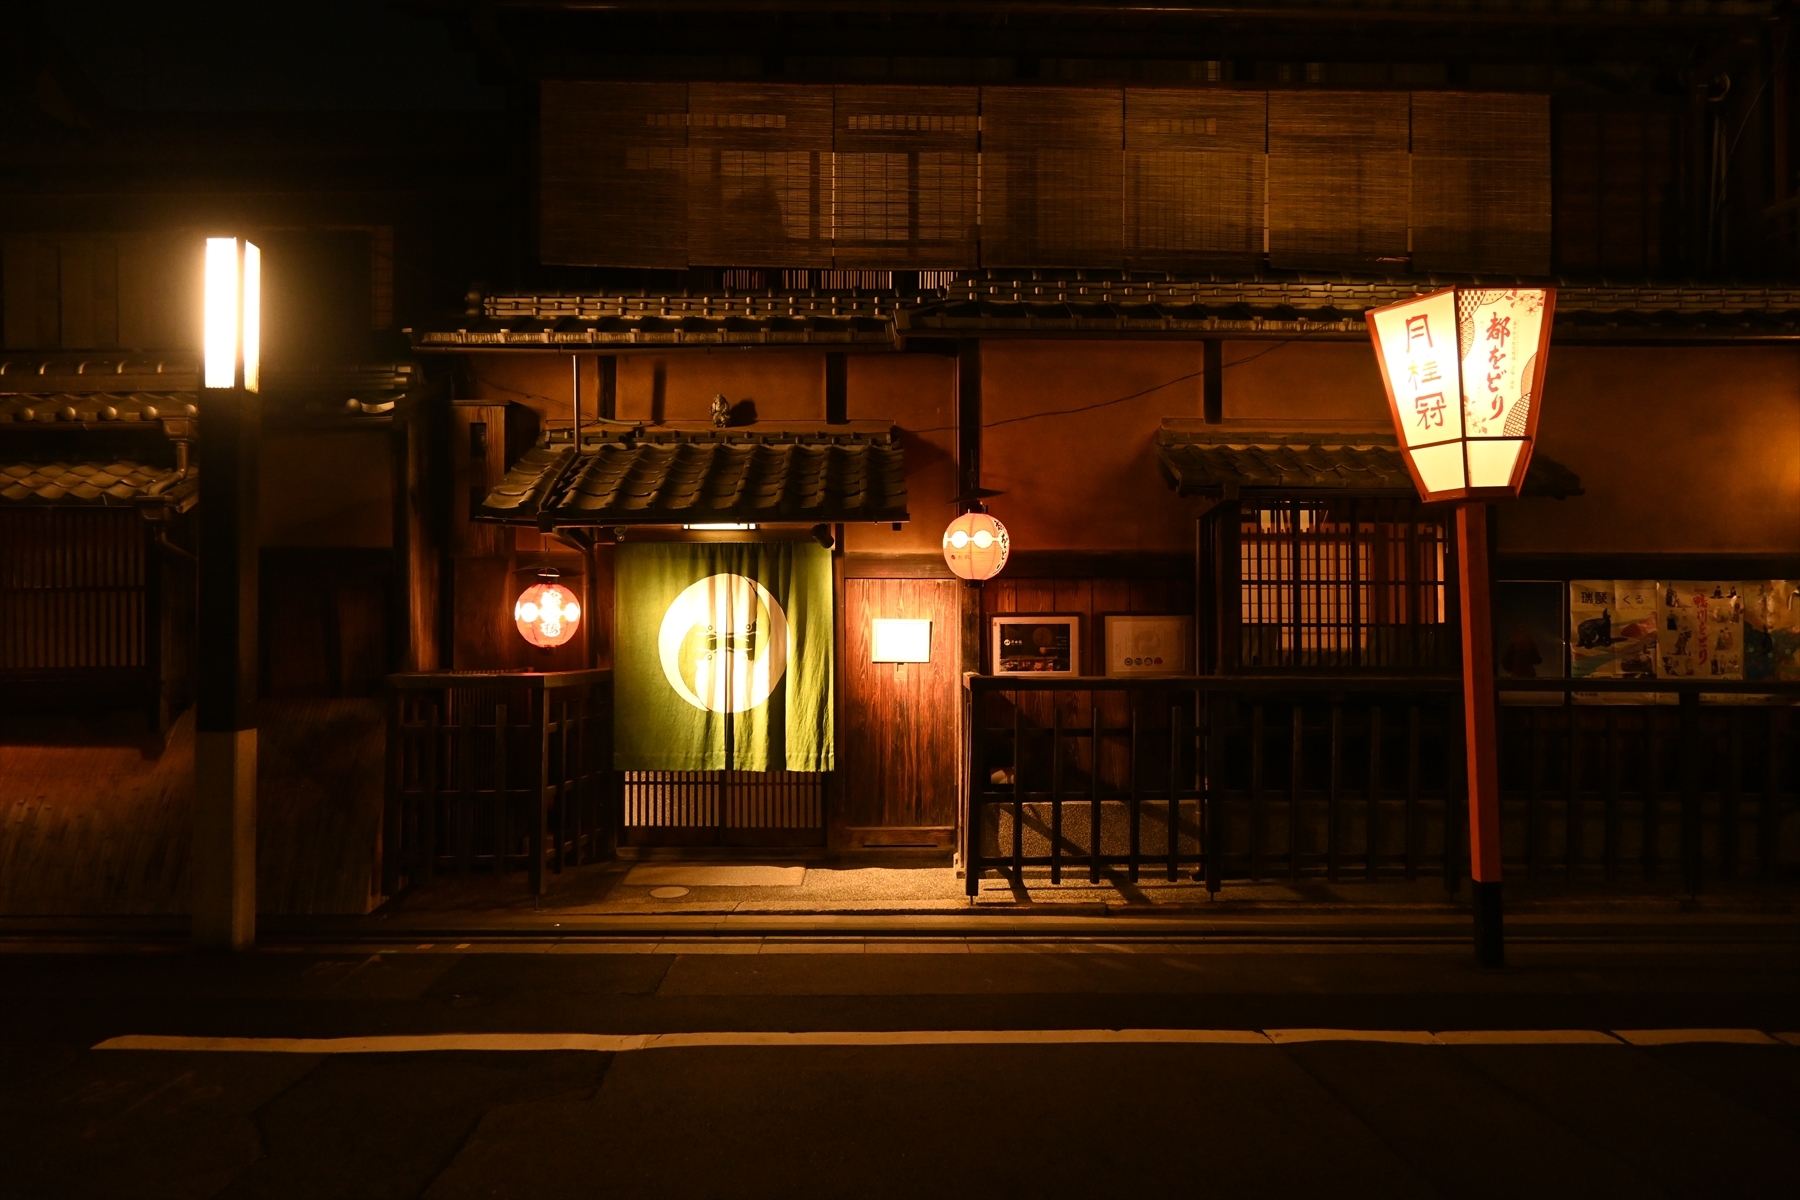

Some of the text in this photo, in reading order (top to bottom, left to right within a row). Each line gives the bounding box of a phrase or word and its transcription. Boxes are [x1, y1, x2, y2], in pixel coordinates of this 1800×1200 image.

[1405, 313, 1447, 431] 月桂冠
[1485, 311, 1512, 421] 都をどり
